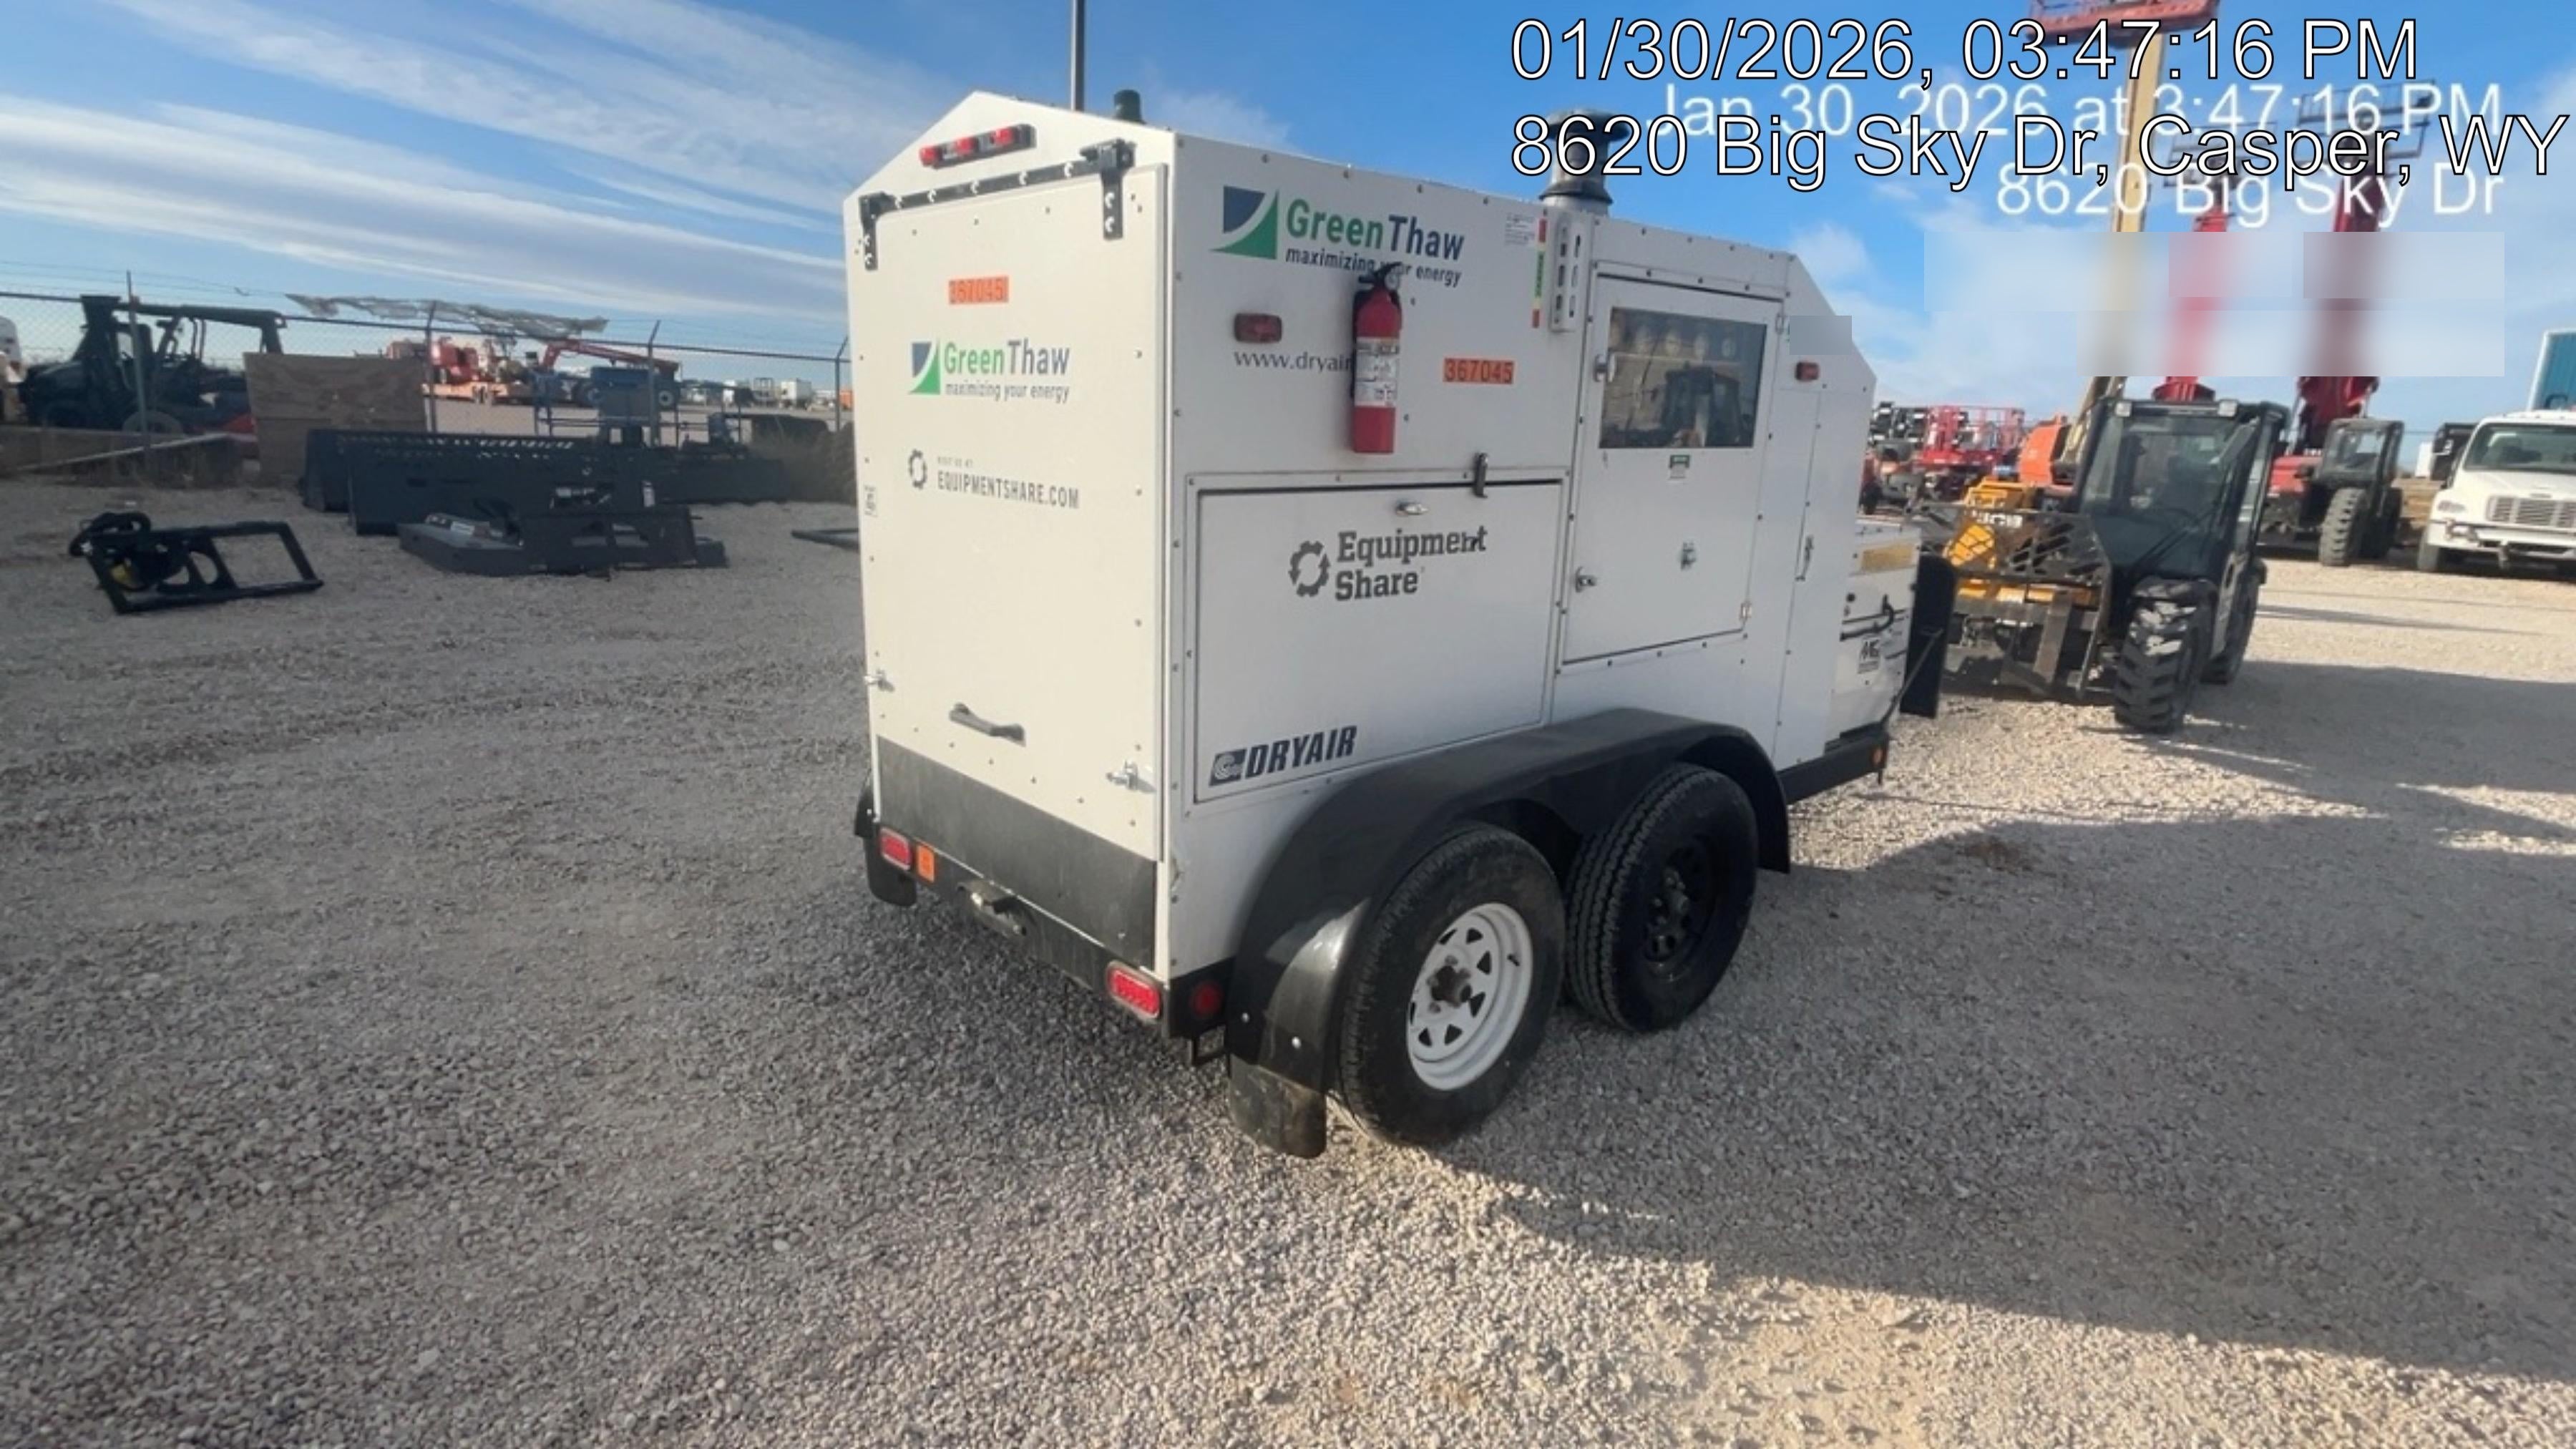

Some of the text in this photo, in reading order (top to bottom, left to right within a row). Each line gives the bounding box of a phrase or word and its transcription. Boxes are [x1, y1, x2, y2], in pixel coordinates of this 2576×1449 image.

[1415, 263, 1461, 288] energy
[1444, 358, 1513, 384] 367045
[945, 379, 1070, 404] maximizing your energy
[937, 470, 1080, 509] EQUIPMENTSHARE.COM
[1337, 525, 1488, 567] Equipment
[1335, 569, 1418, 602] Share
[1245, 726, 1357, 779] DRYAIR
